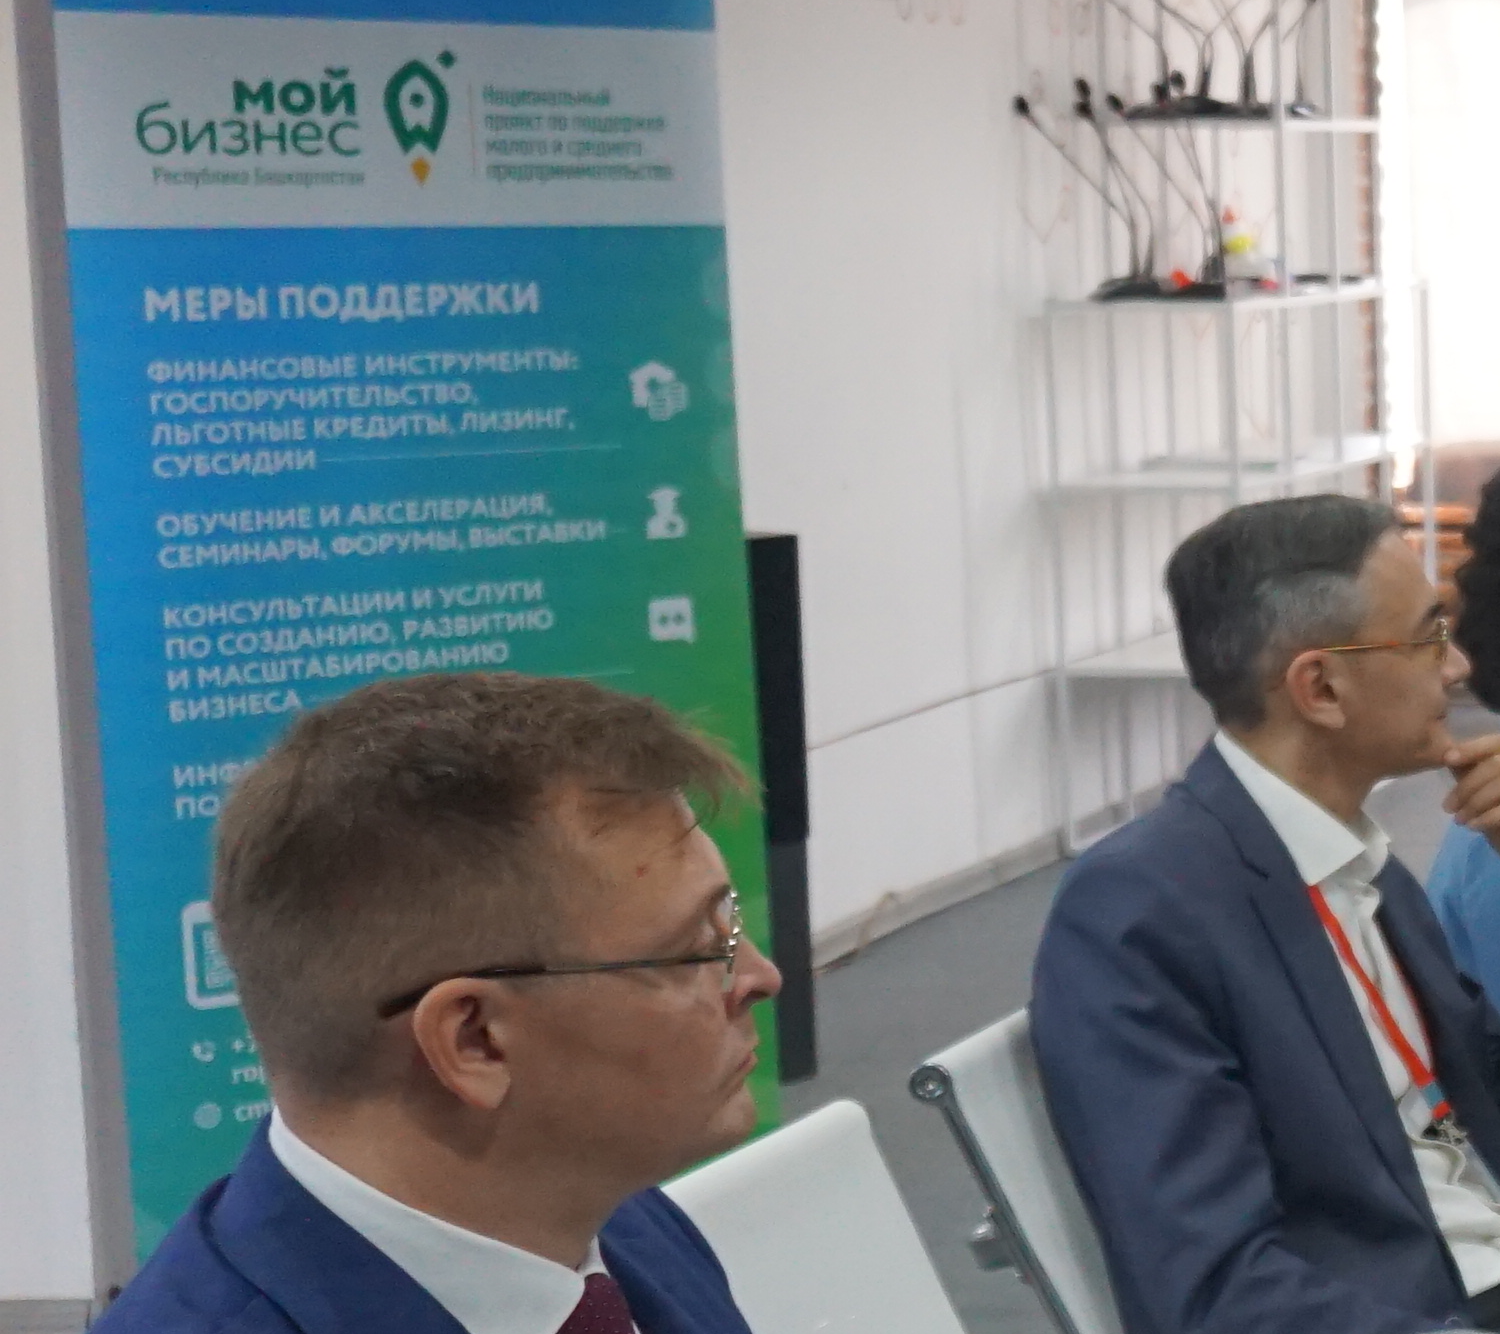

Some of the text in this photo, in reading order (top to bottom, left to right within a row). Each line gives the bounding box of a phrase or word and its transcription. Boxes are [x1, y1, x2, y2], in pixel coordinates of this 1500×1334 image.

[233, 67, 357, 116] мой
[136, 100, 361, 157] бизнес
[144, 280, 540, 324] МЕРЫ ПОДДЕРЖКИ
[147, 347, 579, 384] ФИНАНСОВЫЕ ИНСТРУМЕНТЫ:
[149, 381, 480, 415] ГОСПОРУЧИТЕЛЬСТВО,
[151, 416, 306, 447] ЛЬГОТНЫЕ
[151, 447, 317, 479] СУБСИДИИ
[156, 504, 312, 539] ОБУЧЕНИЕ
[319, 504, 340, 527] И
[469, 519, 608, 549] ВЫСТАВКИ
[163, 579, 544, 630] КОНСУЛЬТАЦИИ И УСЛУГИ
[165, 637, 211, 661] ПО
[403, 607, 556, 642] РАЗВИТИЮ
[167, 641, 510, 692] И МАСШТАБИРОВАНИЮ
[168, 688, 299, 724] БИЗНЕСА
